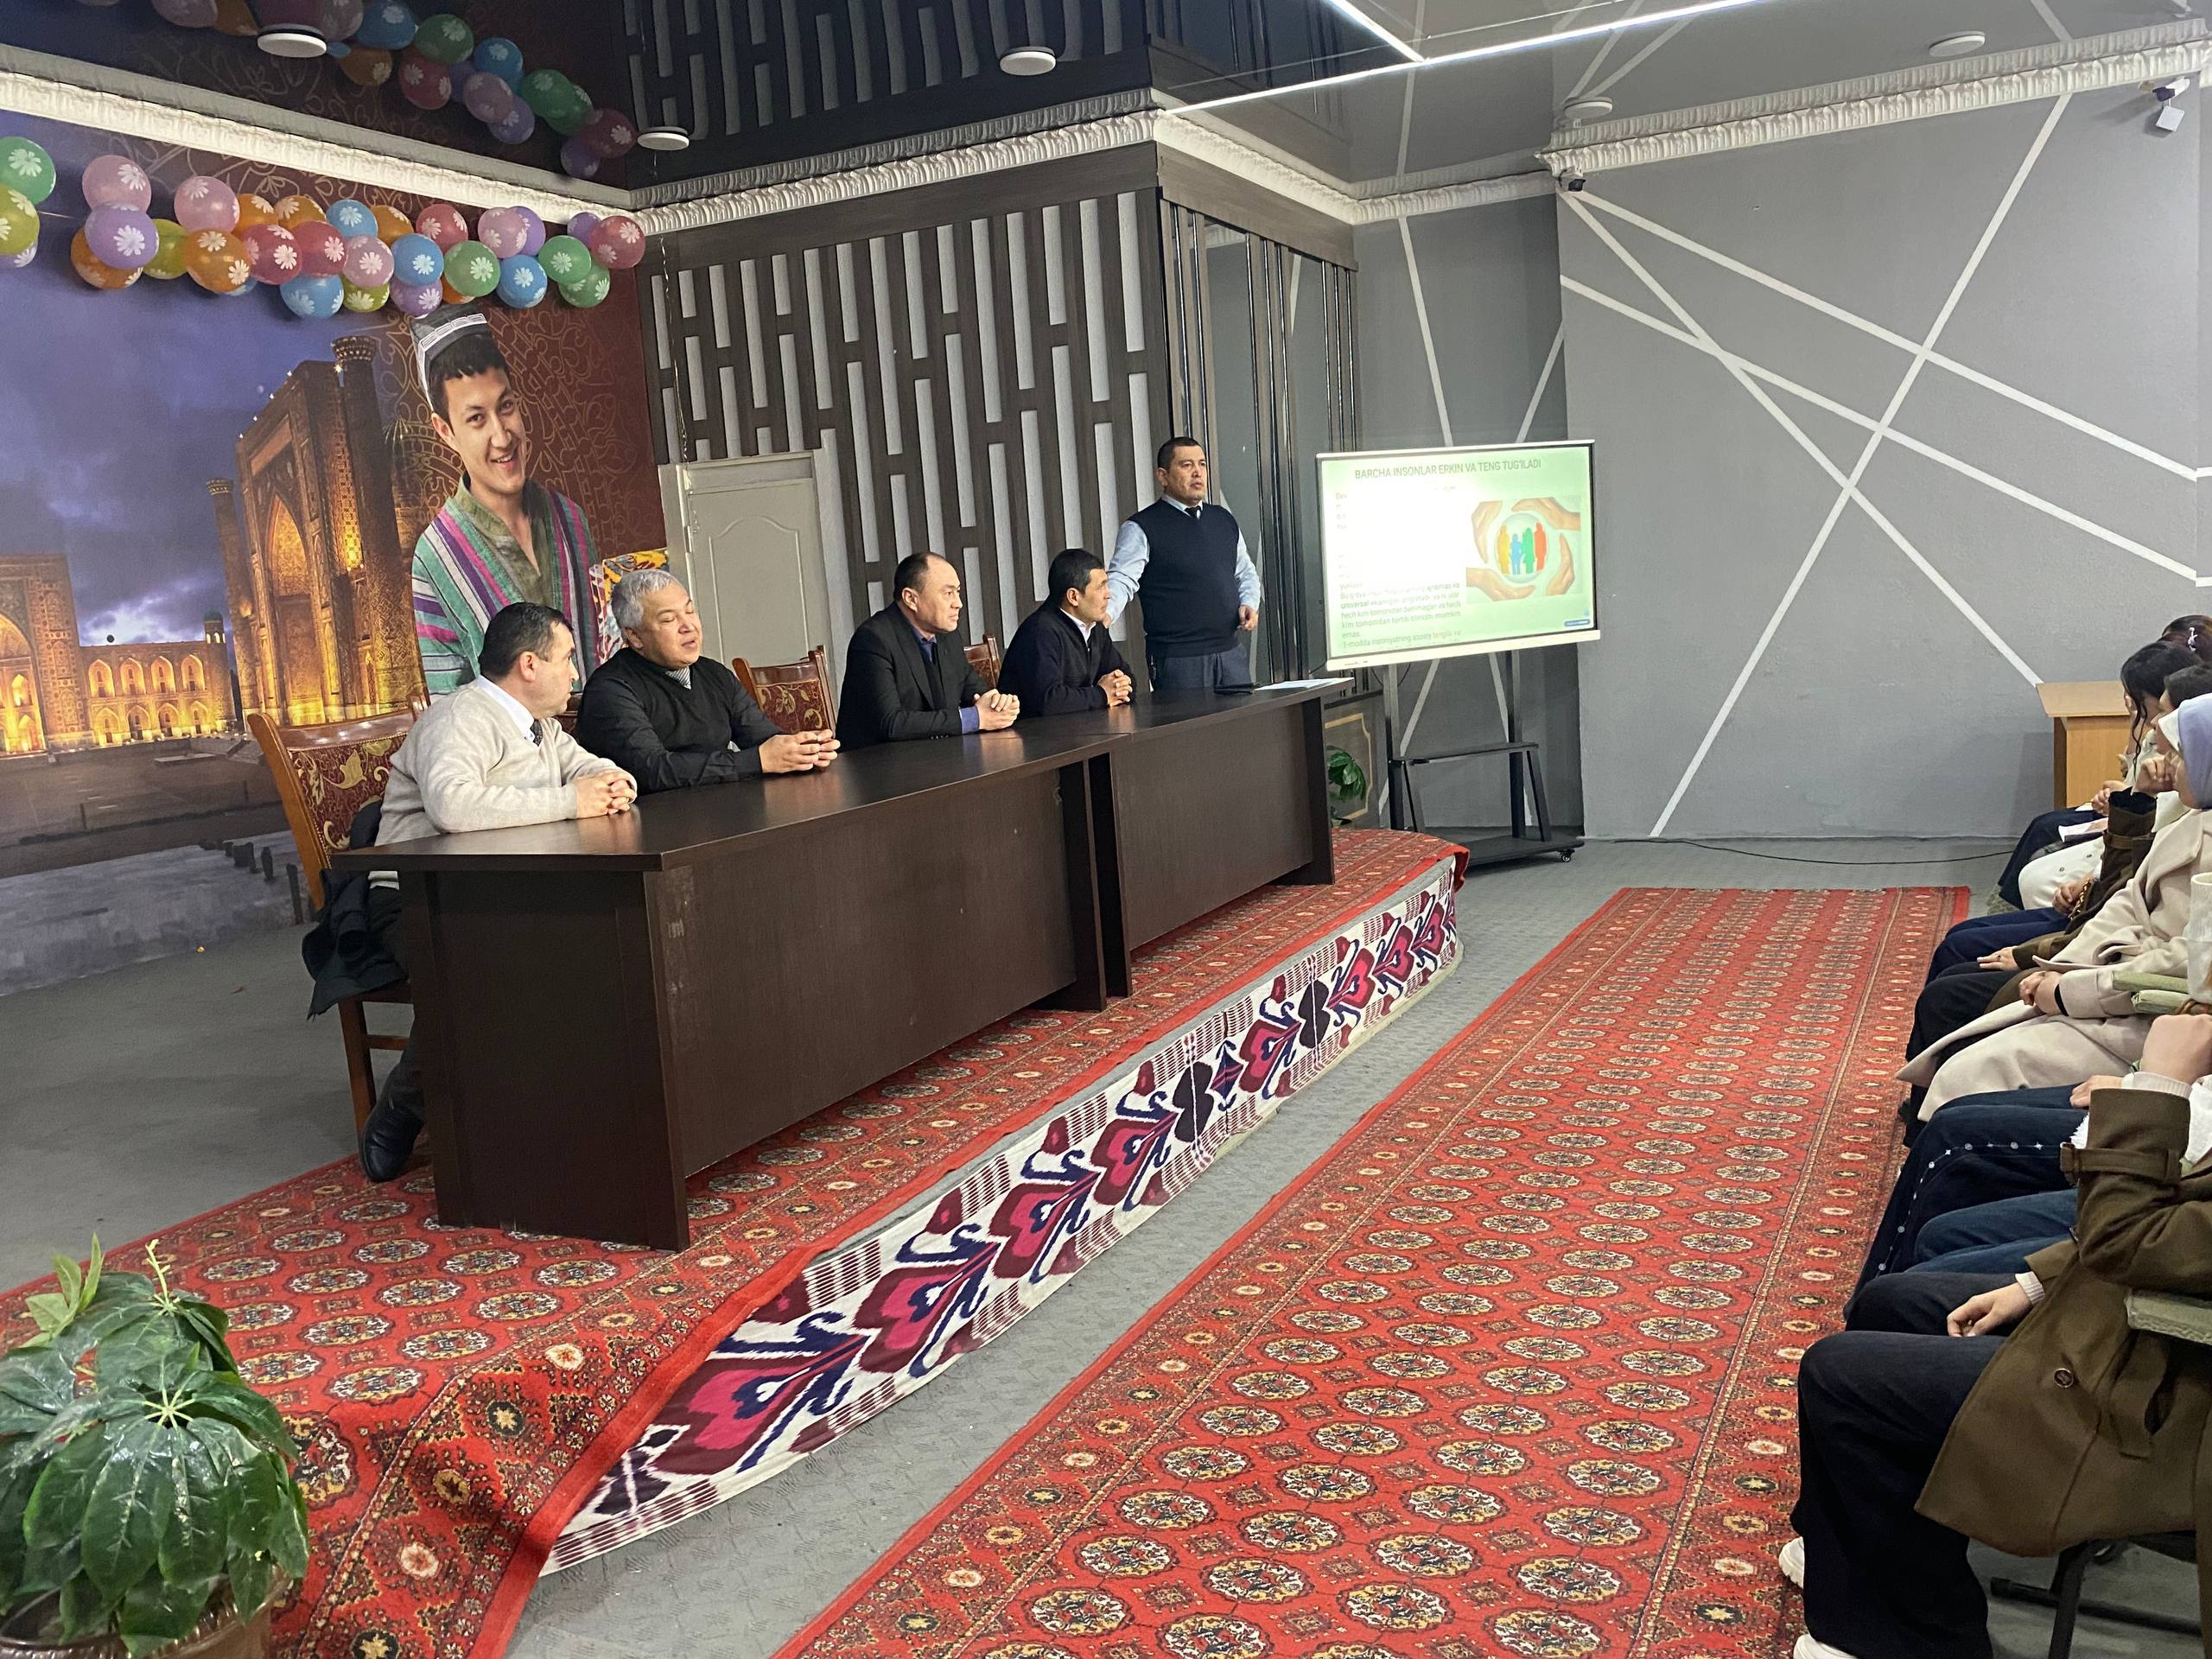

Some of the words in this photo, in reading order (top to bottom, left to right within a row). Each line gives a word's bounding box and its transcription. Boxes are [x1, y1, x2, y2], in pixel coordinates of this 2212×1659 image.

[1355, 467, 1391, 479] BARCHA
[1393, 465, 1437, 477] INSONLAR
[1439, 462, 1464, 474] ERKIN
[1465, 462, 1478, 473] VA
[1478, 461, 1501, 472] TENG
